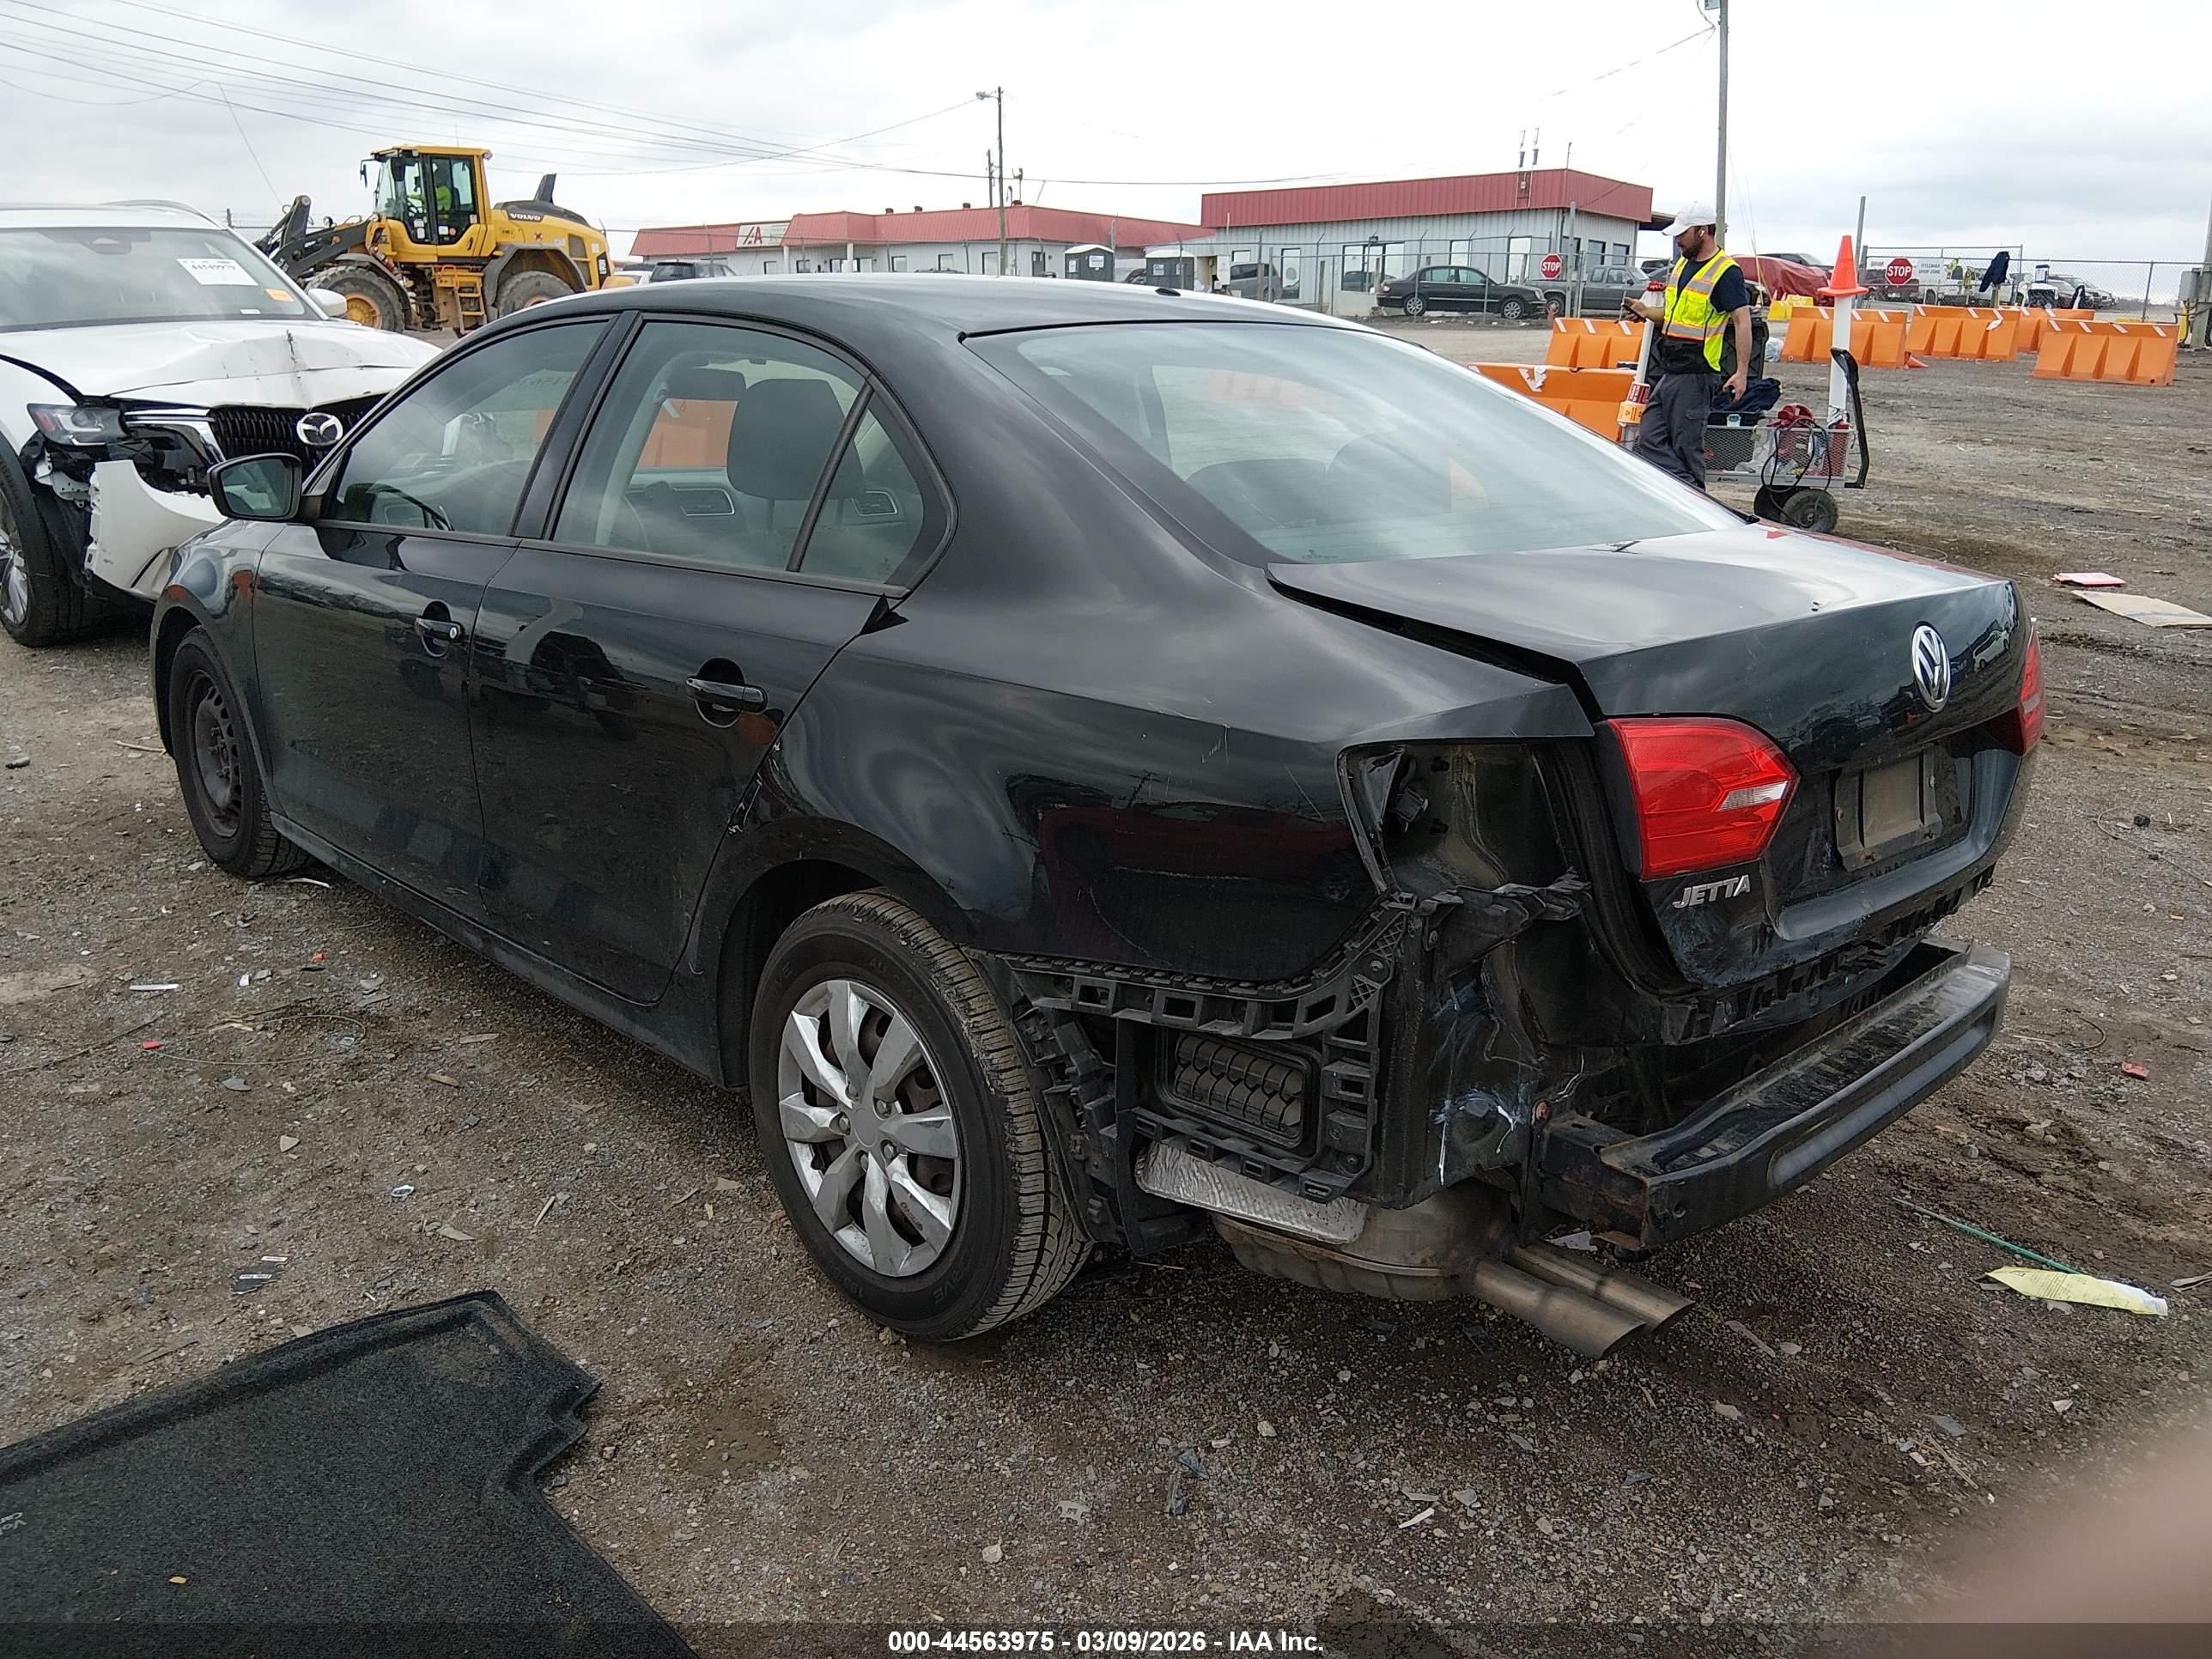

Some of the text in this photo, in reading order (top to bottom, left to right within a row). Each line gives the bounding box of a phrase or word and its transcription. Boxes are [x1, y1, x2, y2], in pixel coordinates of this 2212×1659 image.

[1541, 261, 1560, 271] STOP
[1887, 266, 1911, 276] STOP
[1672, 874, 1750, 908] JETTA
